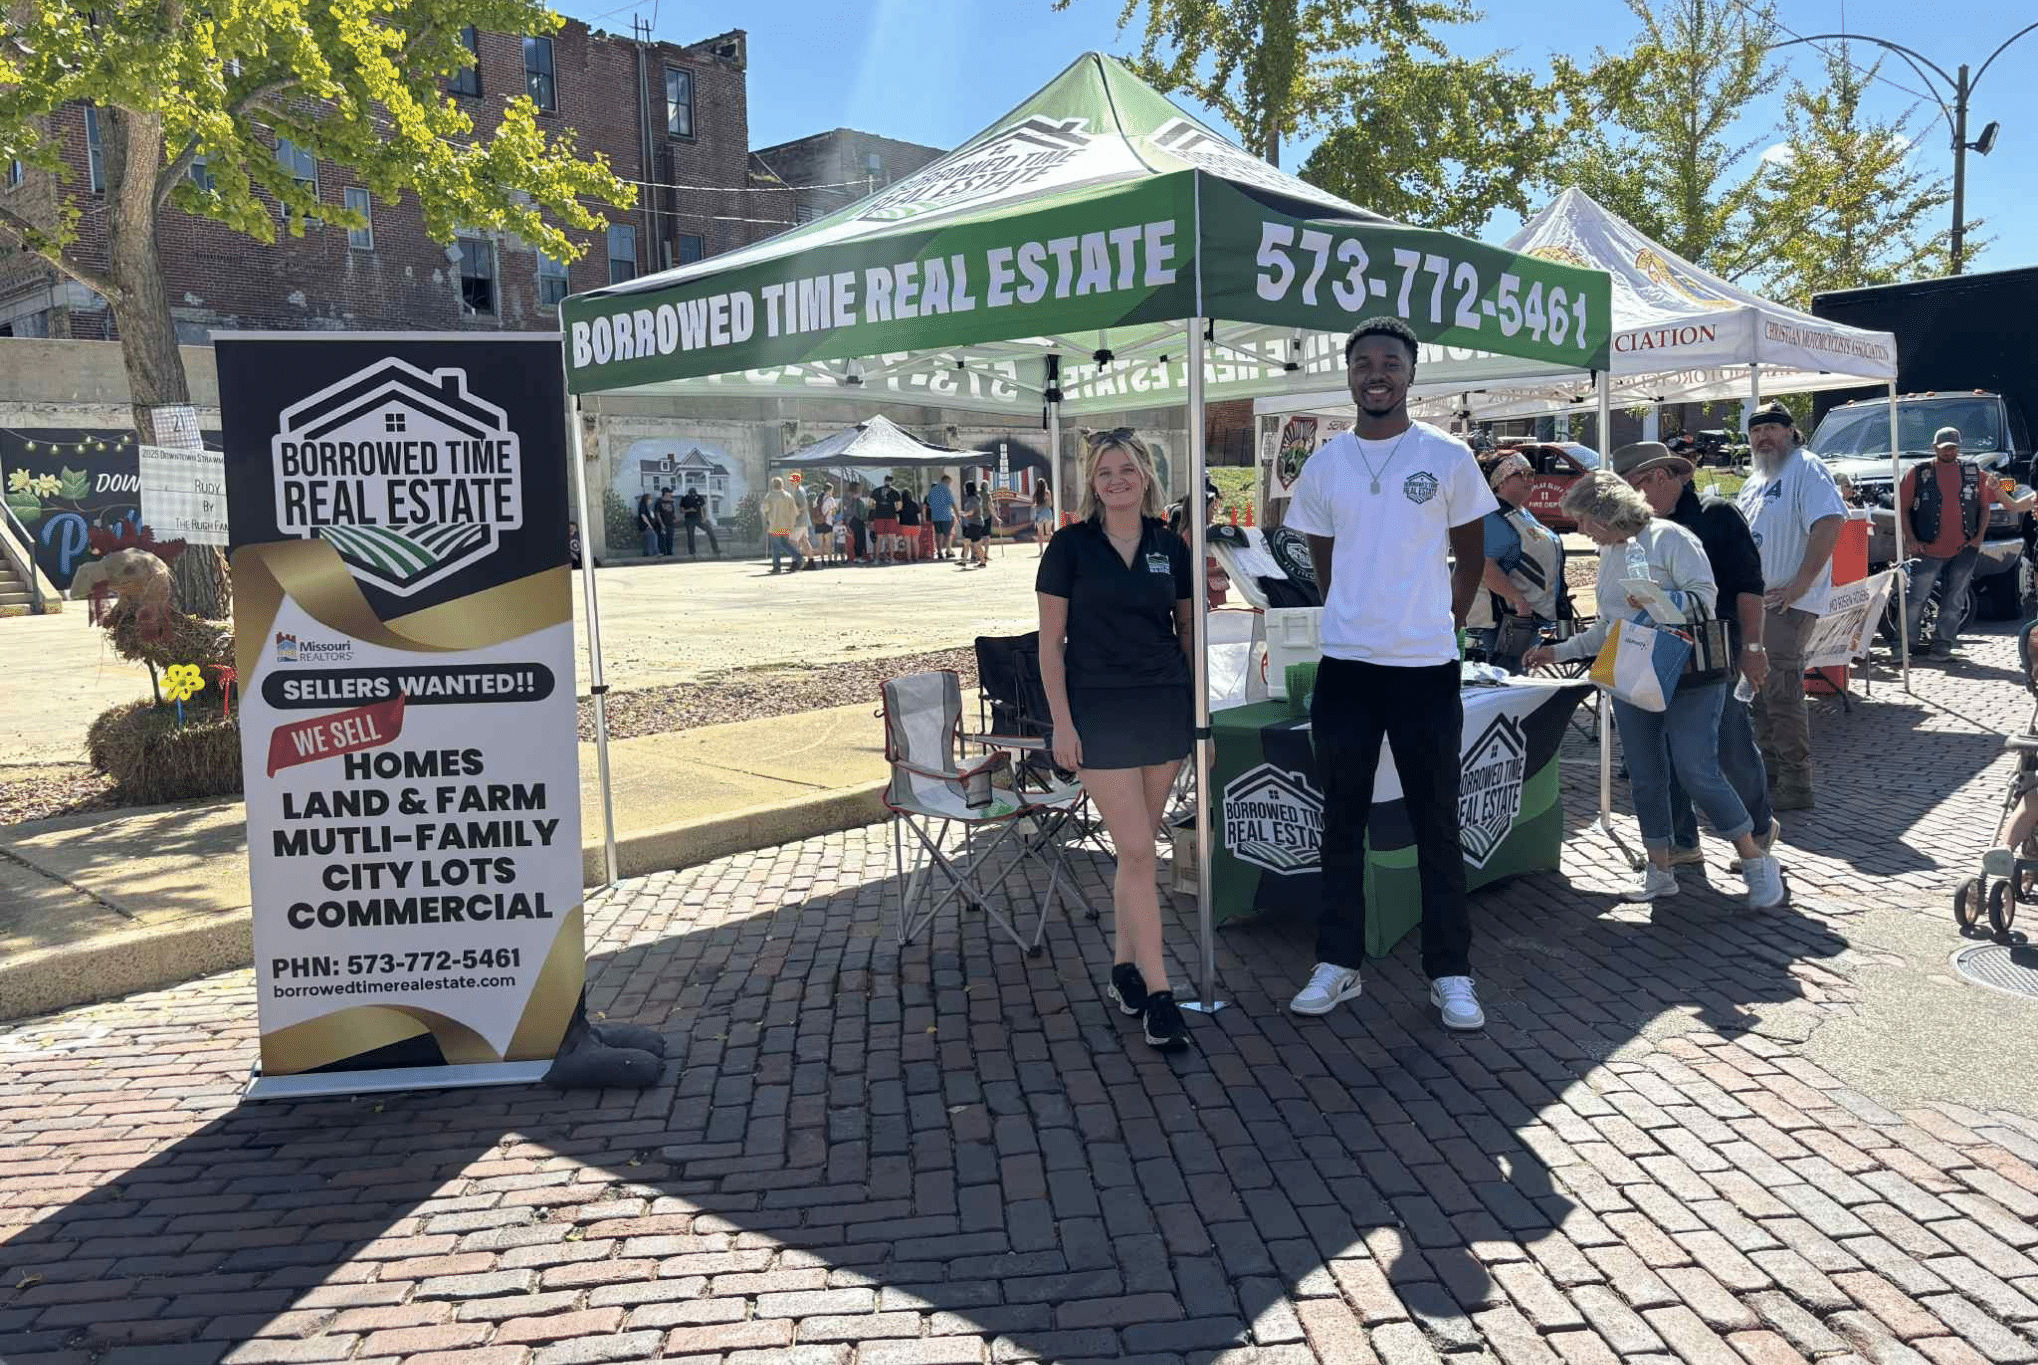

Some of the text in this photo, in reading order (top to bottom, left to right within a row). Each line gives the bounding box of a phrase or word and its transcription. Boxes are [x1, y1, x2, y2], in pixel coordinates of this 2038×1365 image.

[572, 219, 1177, 368] BORROWED TIME REAL ESTATE
[1256, 221, 1588, 350] 573-772-5461
[1611, 323, 1717, 352] CIATION
[281, 440, 512, 476] BORROWED TIME
[284, 478, 514, 527] REAL ESTATE
[300, 640, 351, 652] Missouri
[300, 652, 353, 661] REALTORS
[283, 672, 535, 700] SELLERS WANTED!!
[291, 714, 382, 757] WE SELL
[344, 748, 484, 780] HOMES
[1460, 761, 1503, 797] ORROWED
[283, 783, 546, 819] LAND & FARM
[1226, 802, 1324, 829] BORROWED TIM
[1460, 782, 1520, 828] EAL ESTATE
[273, 818, 560, 857] MUTLI-FAMILY
[1228, 820, 1323, 850] REAL ESTA
[322, 857, 516, 891] CITY LOTS
[287, 892, 553, 930] COMMERCIAL
[272, 948, 521, 979] PHN: 573-772-5461
[273, 974, 516, 998] borrowedtimerealestate.com
